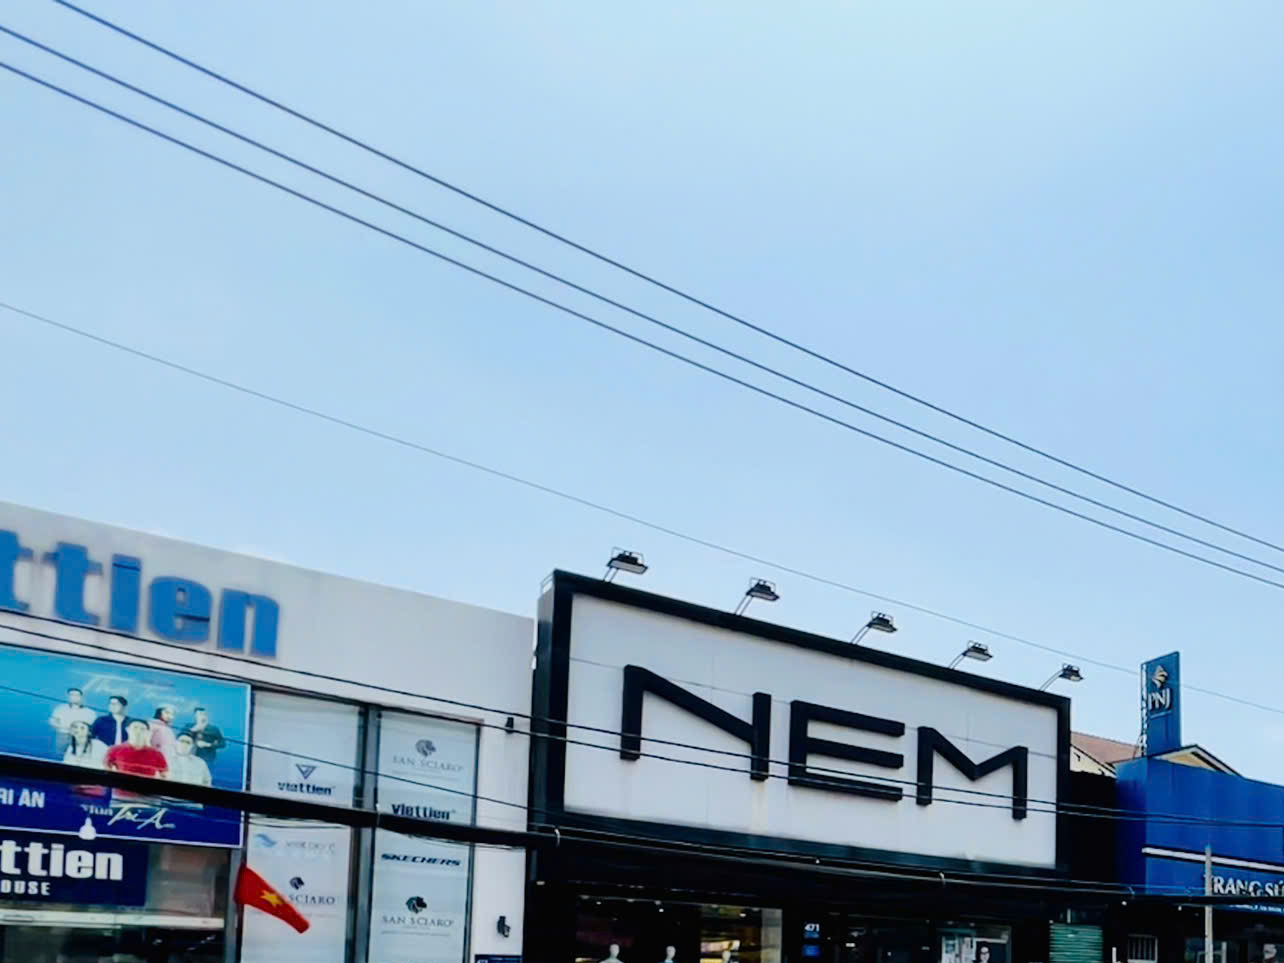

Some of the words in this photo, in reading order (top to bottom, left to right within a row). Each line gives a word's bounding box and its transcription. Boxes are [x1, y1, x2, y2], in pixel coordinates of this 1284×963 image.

[1148, 688, 1171, 711] PNJ
[620, 664, 1029, 820] NEM
[277, 782, 332, 796] viettien
[391, 803, 450, 820] viettien
[381, 853, 461, 866] SKECHERS
[381, 915, 407, 926] SAN
